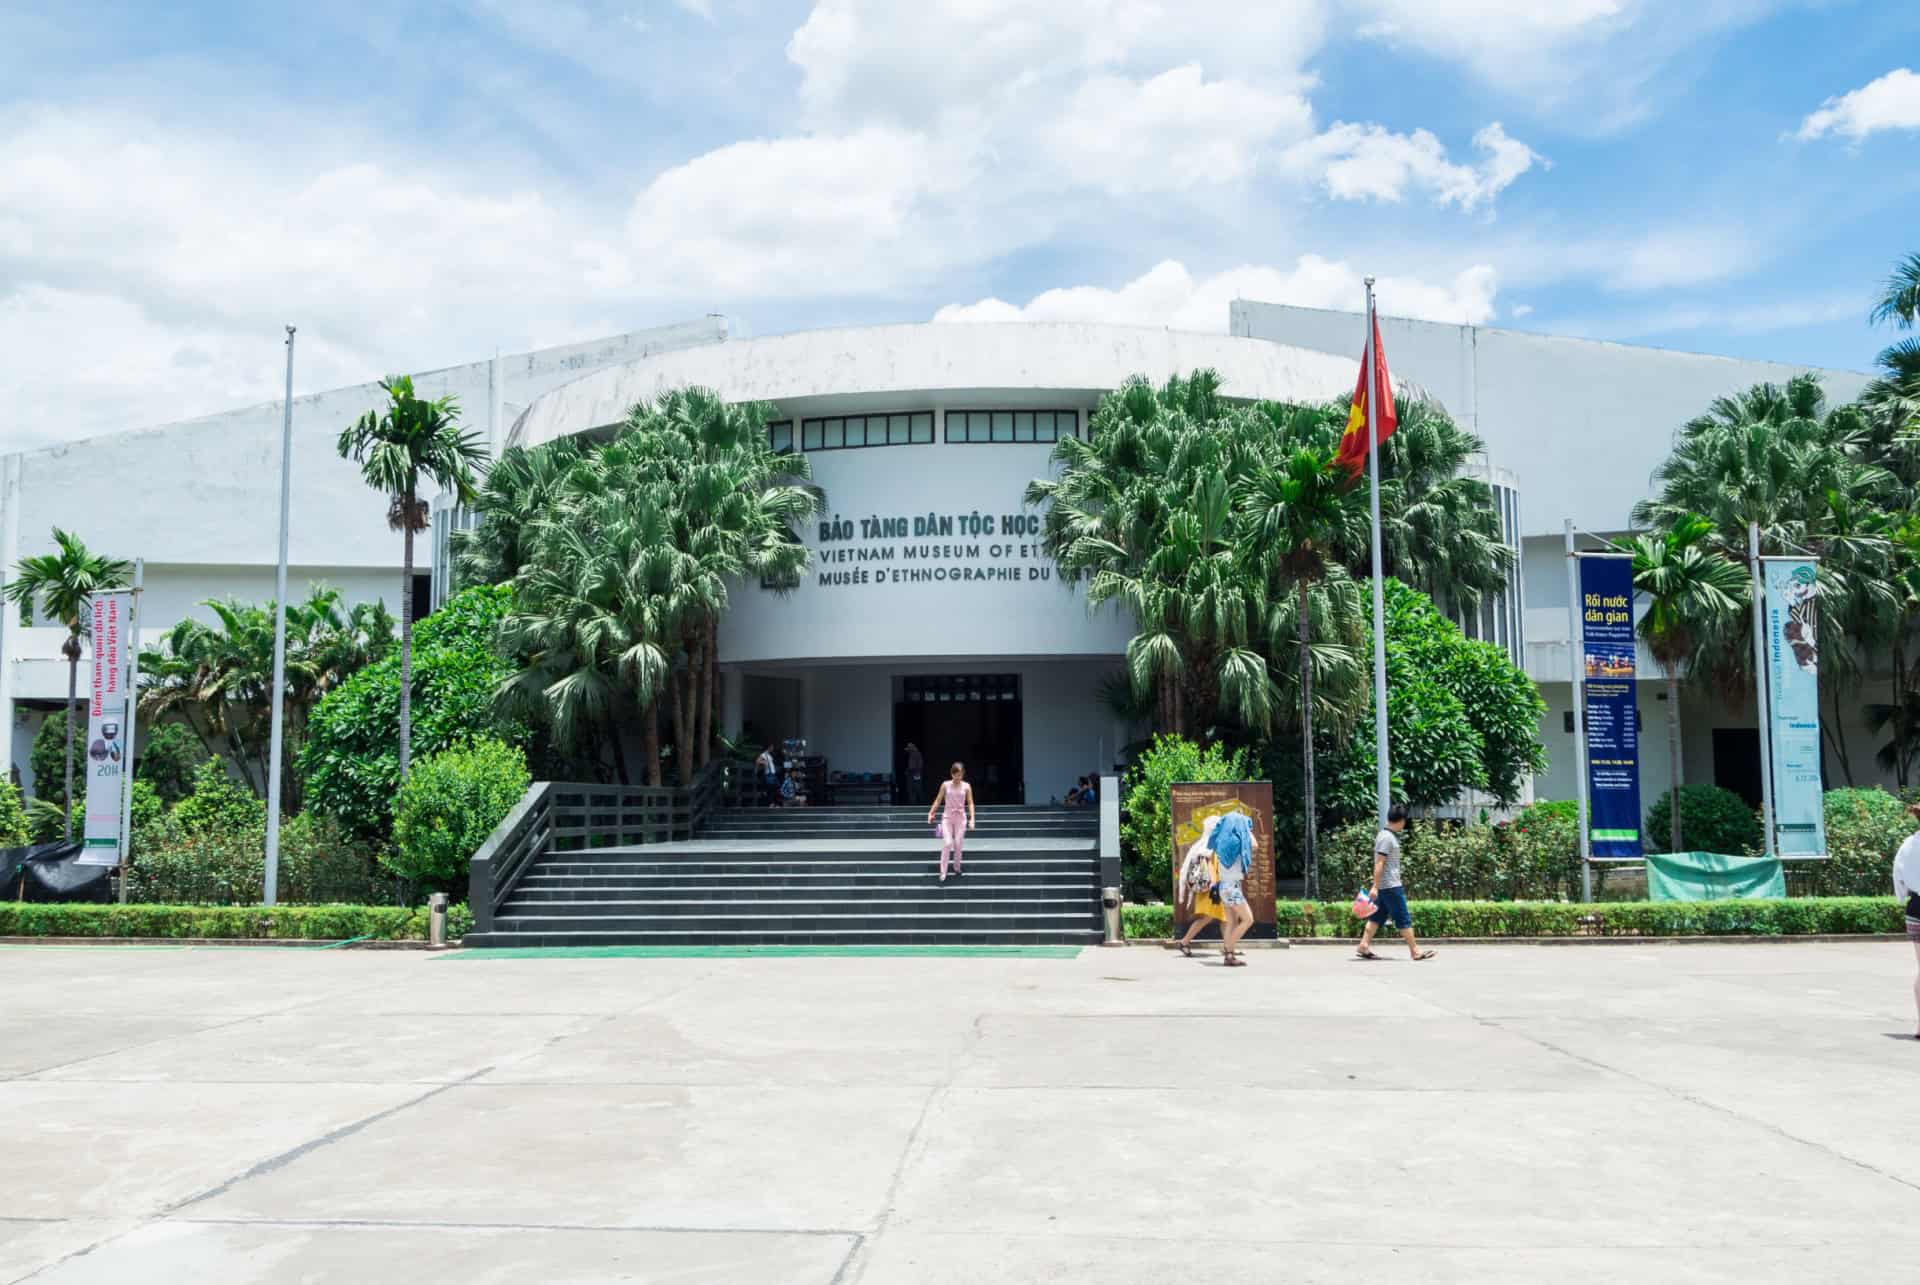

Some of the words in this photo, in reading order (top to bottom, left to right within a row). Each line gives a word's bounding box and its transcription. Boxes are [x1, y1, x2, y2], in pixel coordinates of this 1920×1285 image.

[819, 514, 854, 541] BẢO
[860, 514, 908, 538] TÀNG
[913, 511, 953, 536] DÂN
[958, 510, 994, 539] TỘC
[1001, 514, 1039, 539] HỌC
[820, 547, 894, 563] VIETNAM
[904, 544, 980, 559] MUSEUM
[990, 544, 1013, 558] OF
[819, 567, 869, 586] MUSÉE
[876, 567, 1021, 583] D'ETHNOGRAPHIE
[1029, 568, 1050, 581] DU
[107, 600, 116, 623] Nam
[1585, 608, 1603, 622] dân
[1606, 609, 1628, 625] gian
[94, 635, 104, 660] quan
[1770, 609, 1781, 662] Indonesia
[93, 662, 102, 688] tham
